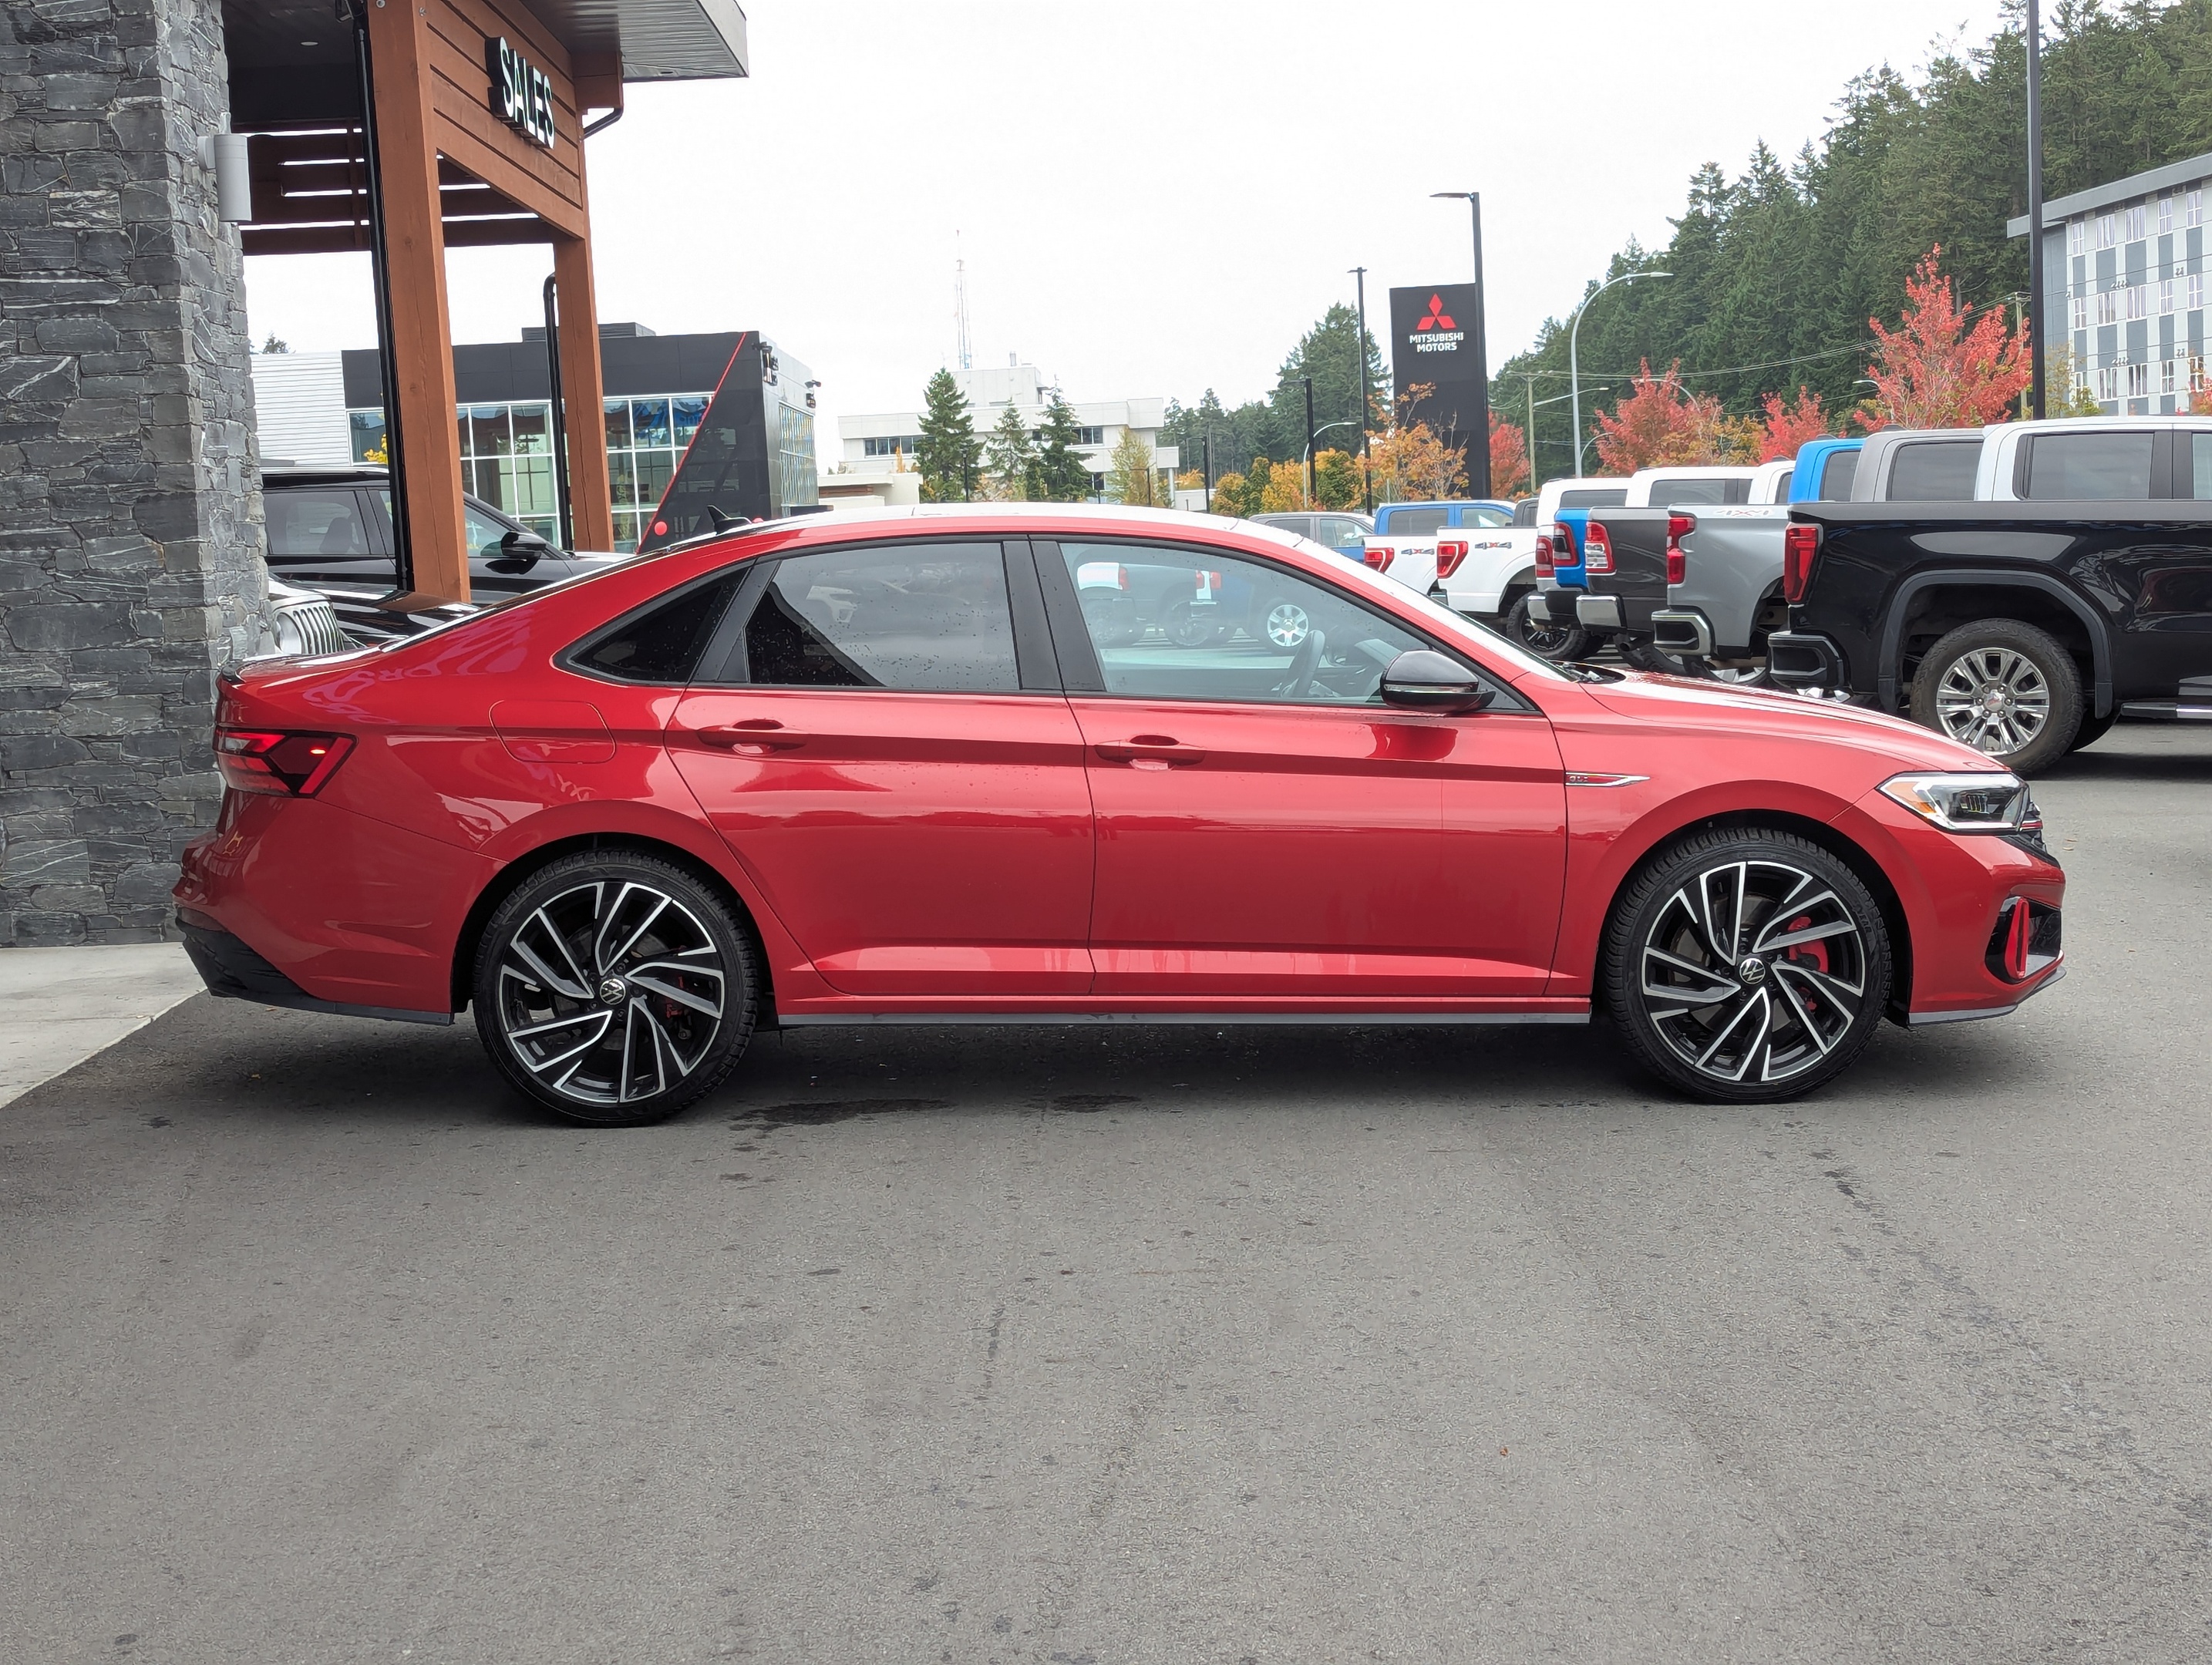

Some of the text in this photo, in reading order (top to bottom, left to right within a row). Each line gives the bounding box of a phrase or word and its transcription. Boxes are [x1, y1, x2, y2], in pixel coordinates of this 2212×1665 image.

[500, 36, 555, 150] SALES
[1409, 331, 1464, 344] MITSUBISHI
[1416, 341, 1457, 353] MOTORS
